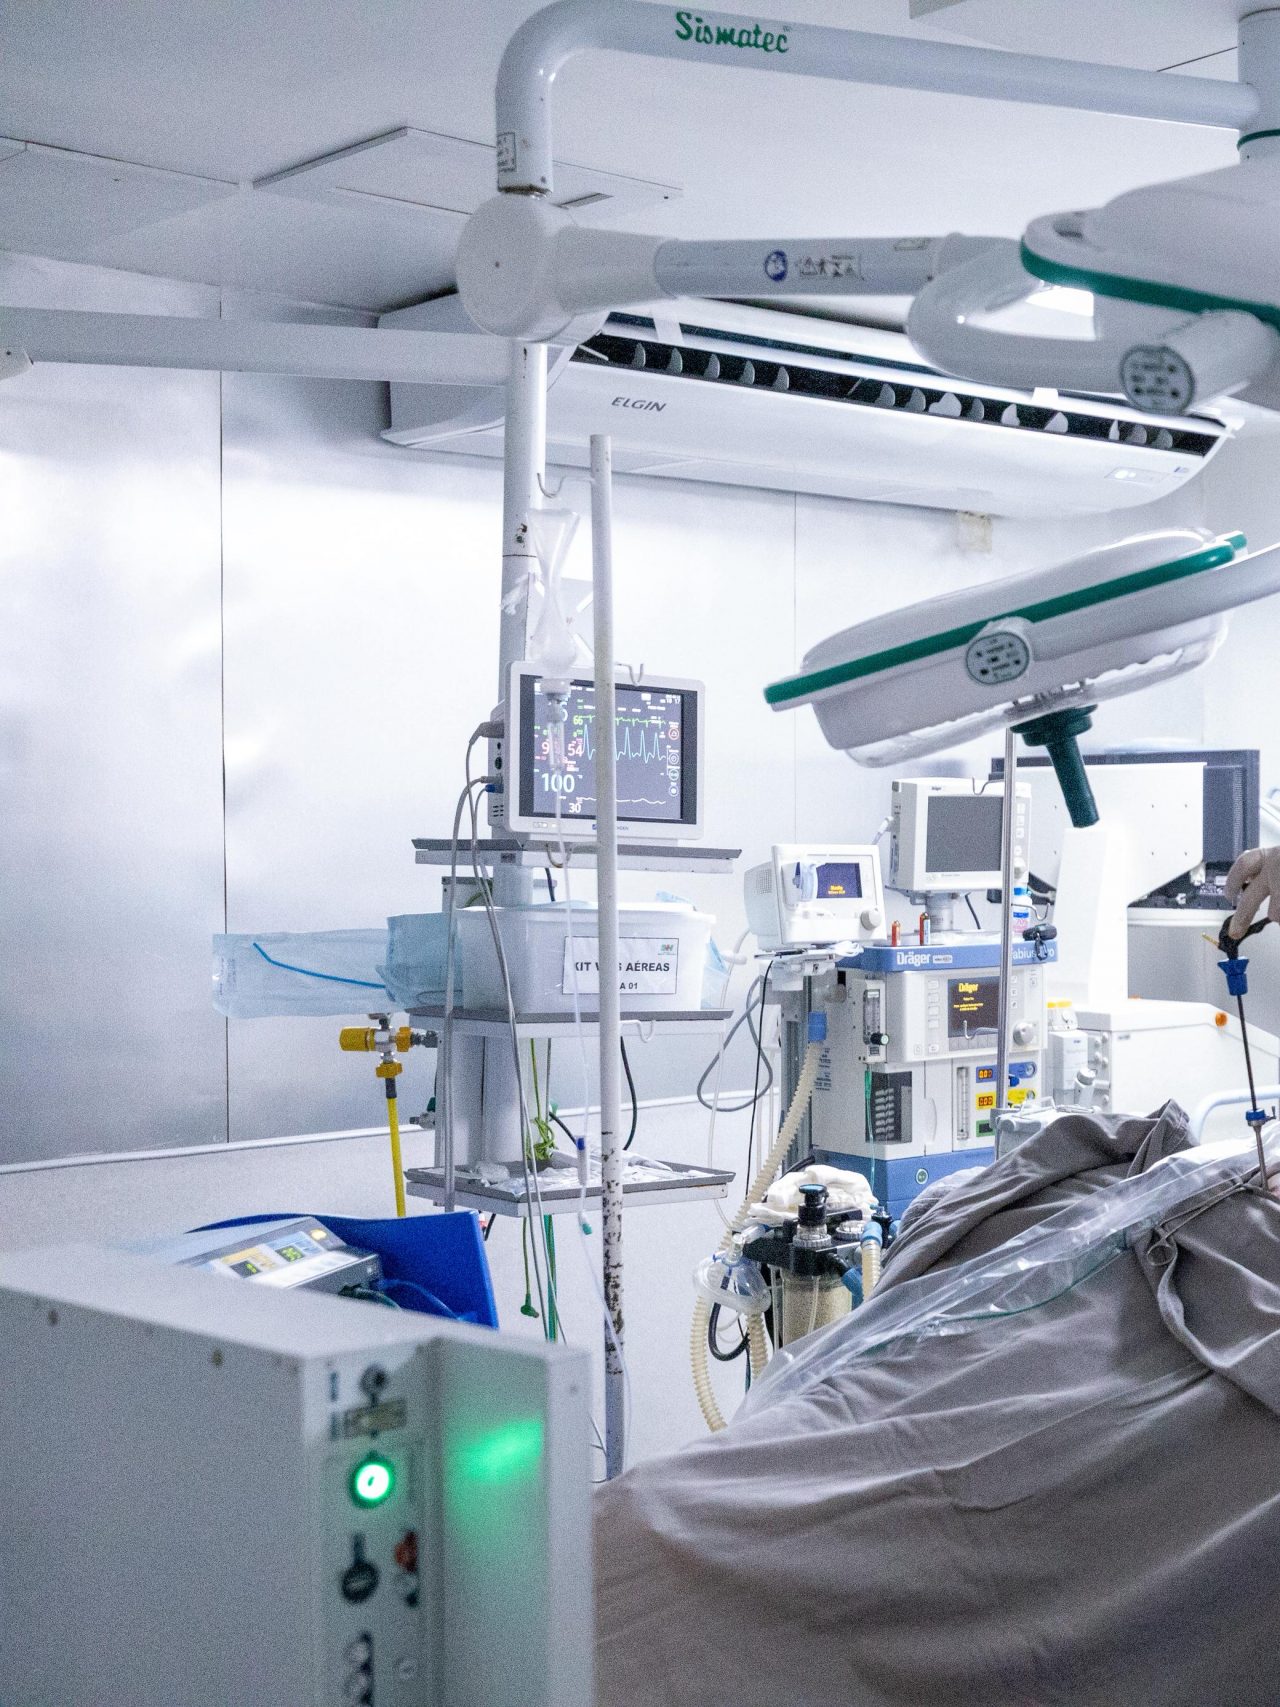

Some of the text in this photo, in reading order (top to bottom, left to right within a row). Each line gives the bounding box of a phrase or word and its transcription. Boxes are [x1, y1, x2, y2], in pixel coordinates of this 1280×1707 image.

[611, 396, 667, 412] ELGIN
[541, 773, 575, 793] 100
[568, 802, 582, 813] 30
[896, 951, 931, 967] Dräger
[1012, 948, 1037, 960] abius
[625, 960, 670, 972] AÉREAS
[628, 982, 638, 990] 01
